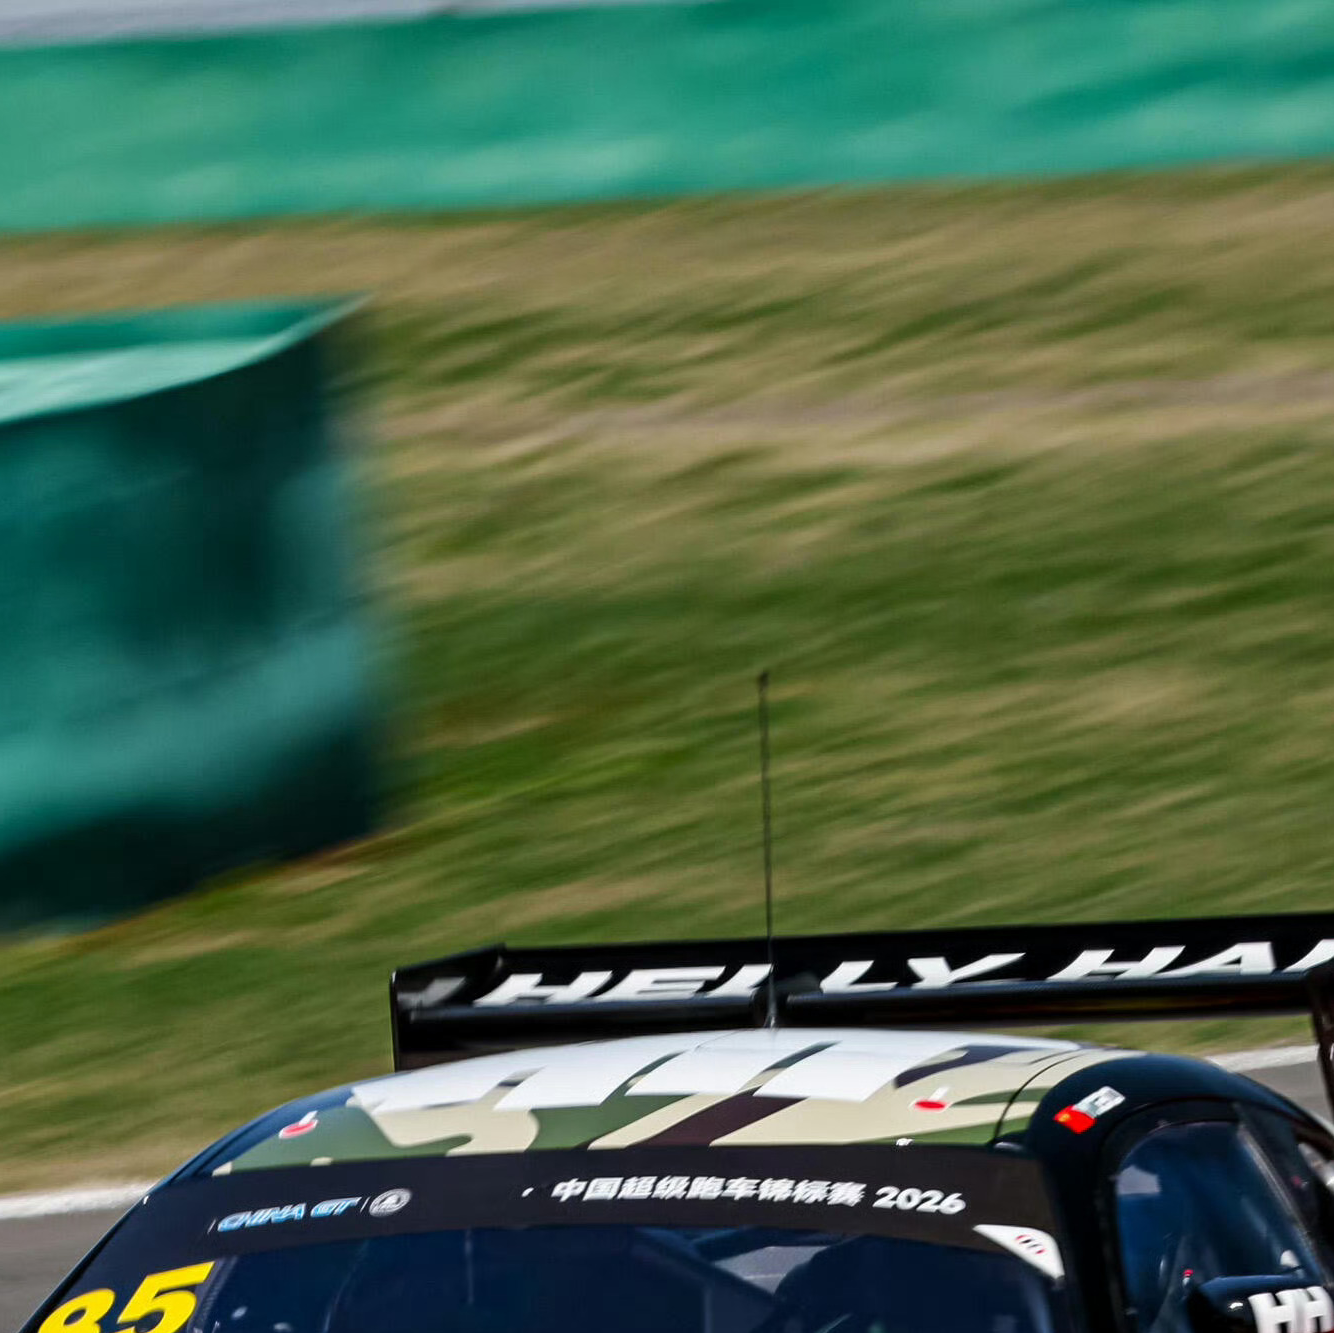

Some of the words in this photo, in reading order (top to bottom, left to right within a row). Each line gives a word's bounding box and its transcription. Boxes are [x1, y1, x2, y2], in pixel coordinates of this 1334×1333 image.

[217, 1203, 307, 1232] CHINA
[310, 1196, 362, 1218] GT
[550, 1175, 867, 1207] 中国超级跑车锦标赛
[872, 1185, 966, 1215] 2026
